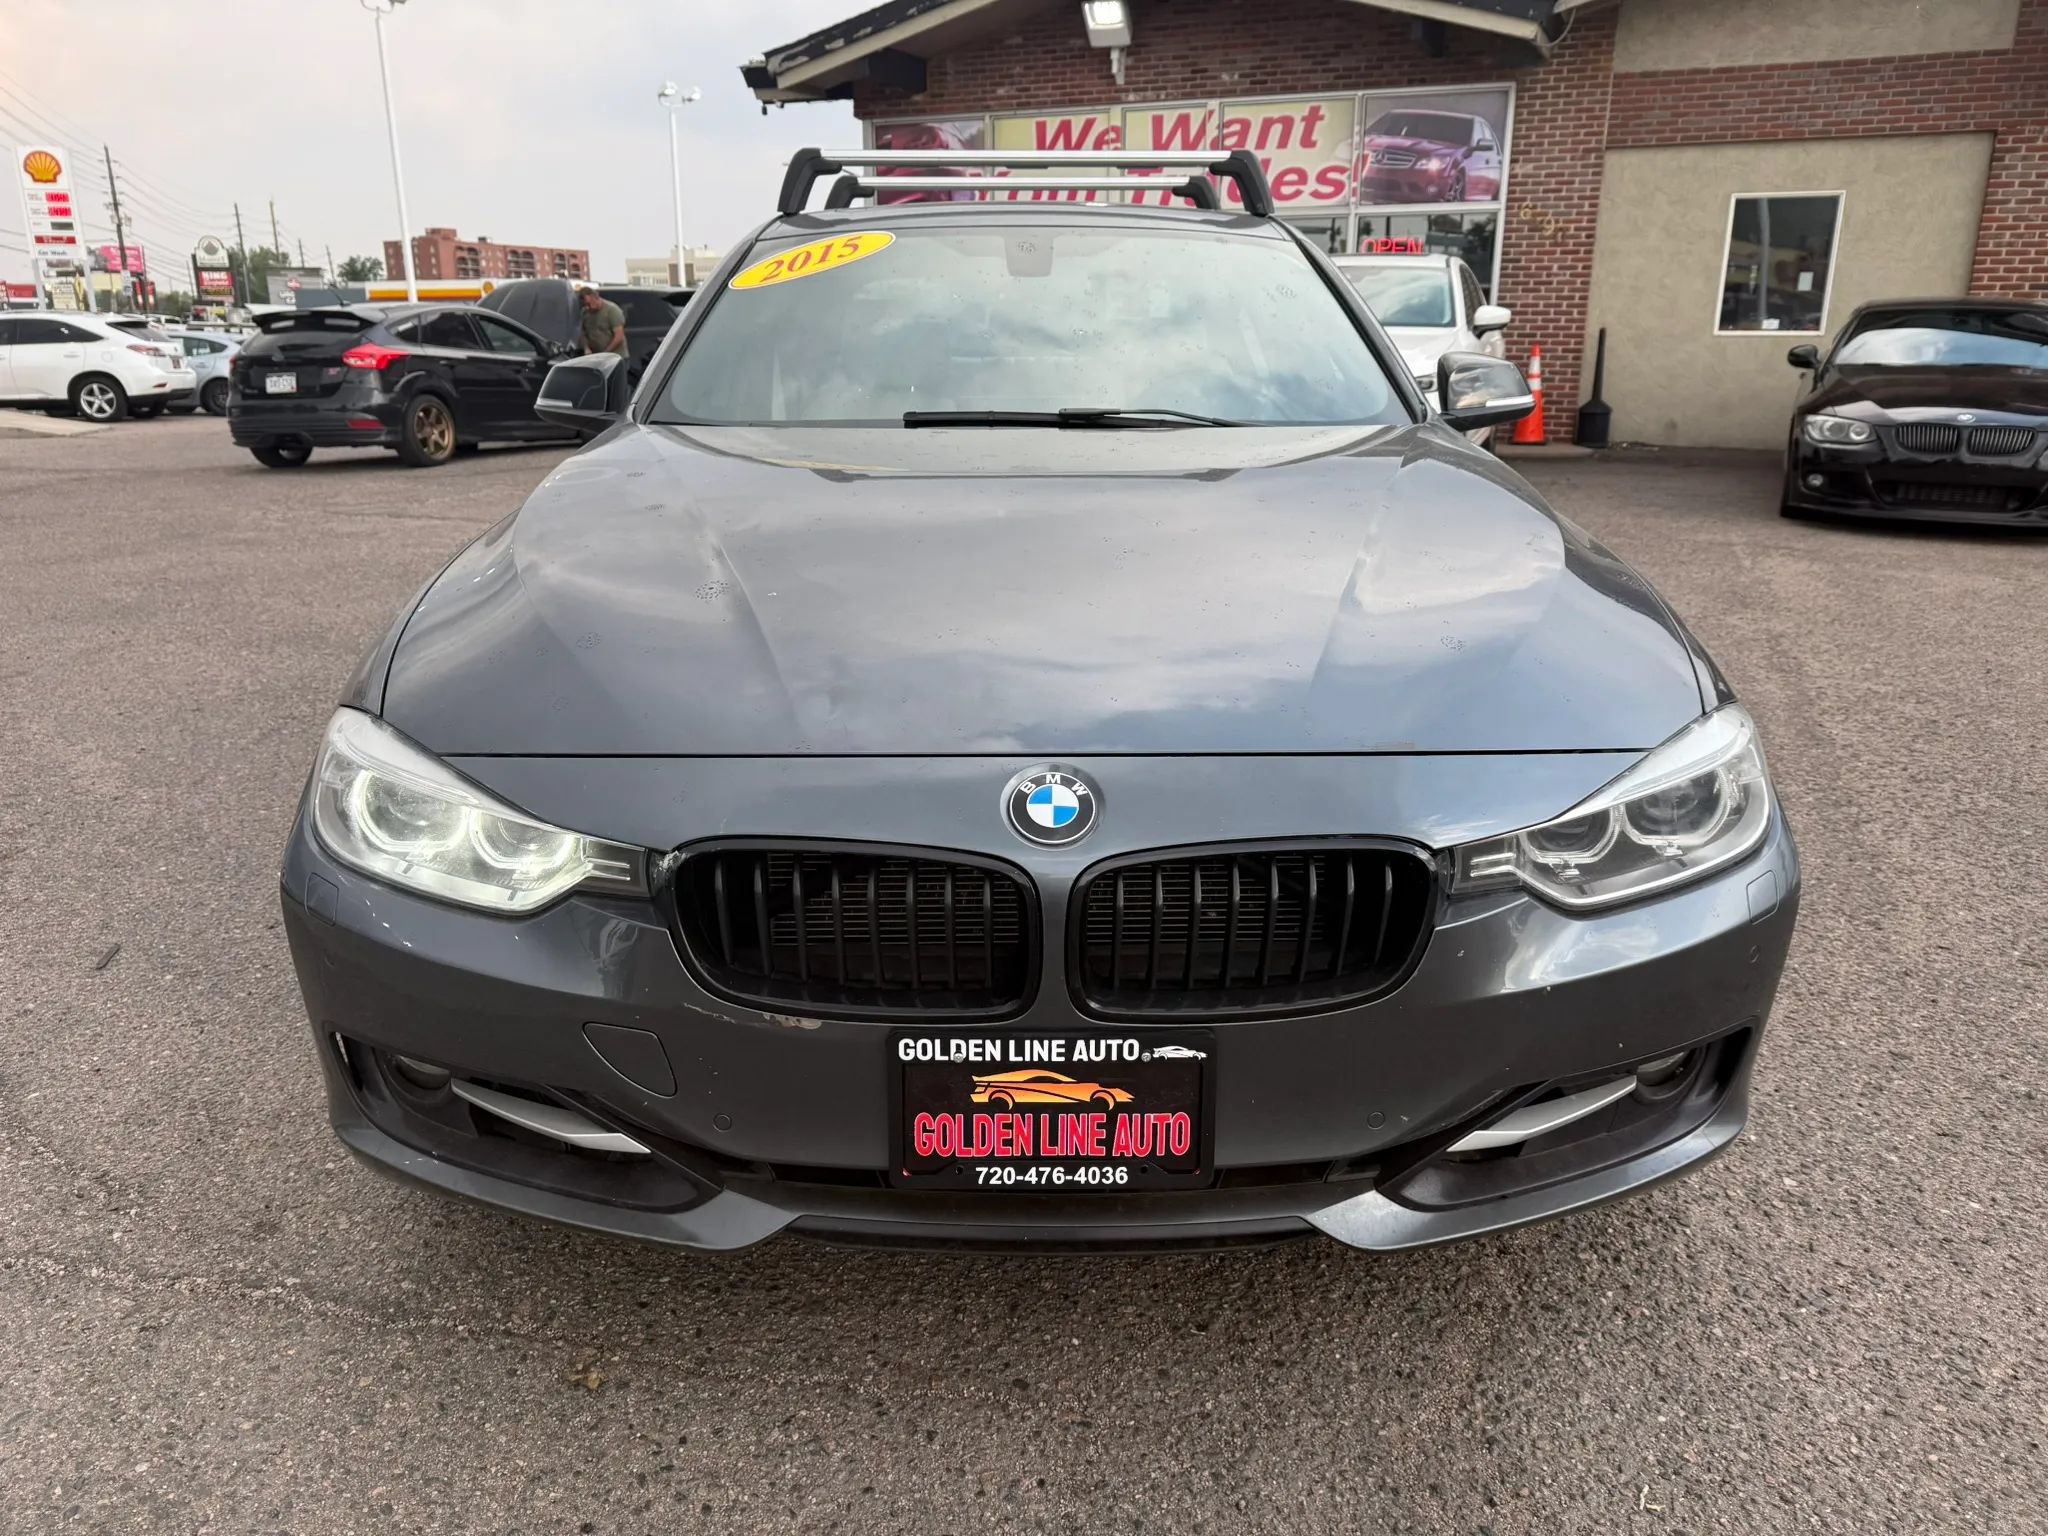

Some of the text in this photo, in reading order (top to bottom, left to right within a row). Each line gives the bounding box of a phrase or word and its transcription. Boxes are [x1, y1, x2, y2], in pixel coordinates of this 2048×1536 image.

[1034, 100, 1325, 151] We Want
[1361, 237, 1424, 254] OPEN
[760, 235, 863, 283] 2015
[1020, 774, 1088, 796] BMW
[899, 1038, 1139, 1062] GOLDEN LINE AUTO
[914, 1111, 1191, 1157] GOLDEN LINE AUTO
[975, 1166, 1129, 1185] 720-476-4036
